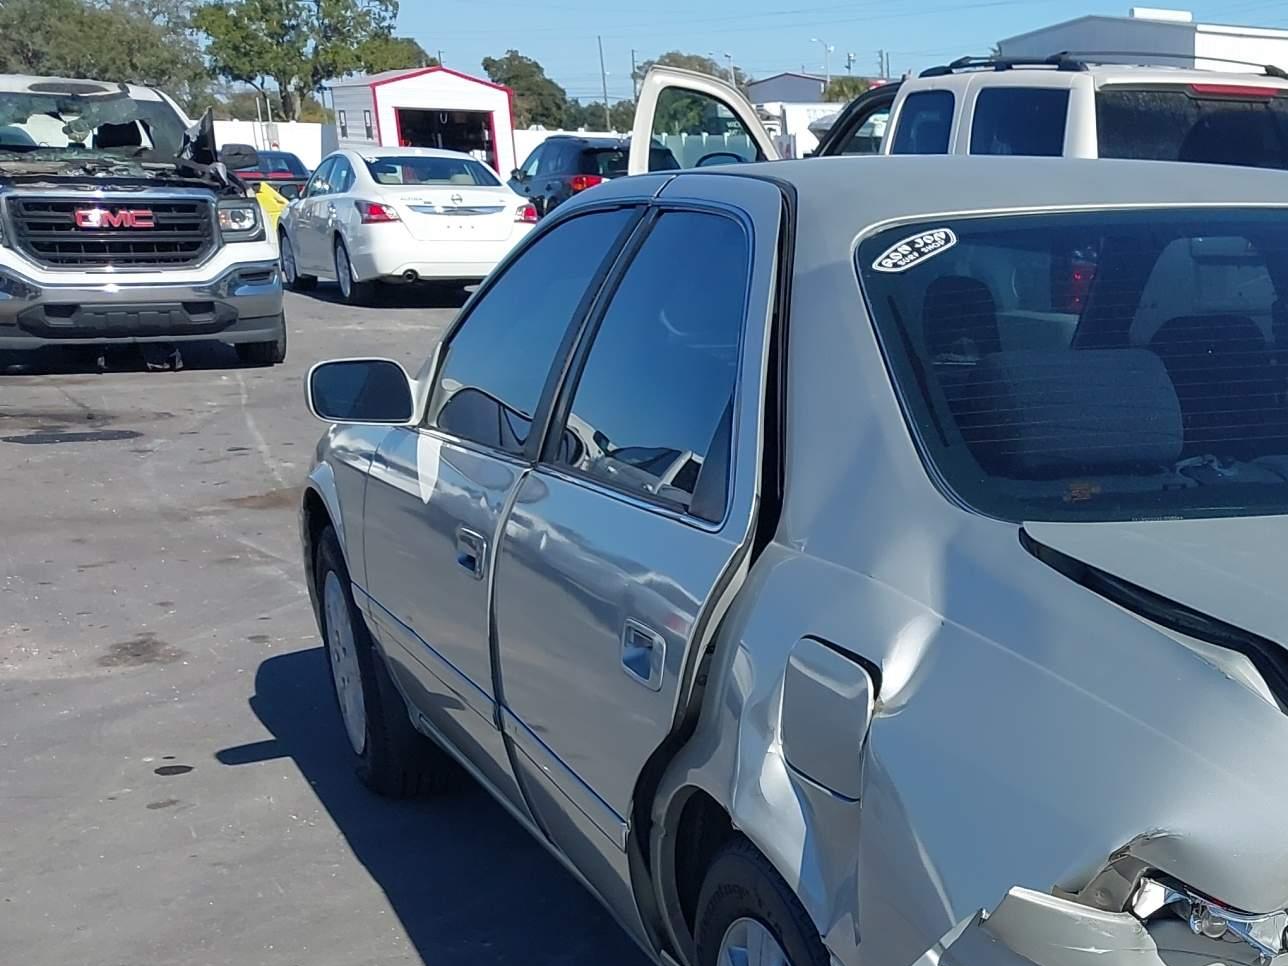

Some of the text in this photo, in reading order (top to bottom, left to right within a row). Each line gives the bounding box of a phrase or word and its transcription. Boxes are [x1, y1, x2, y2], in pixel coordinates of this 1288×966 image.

[75, 209, 154, 227] GMC
[881, 231, 947, 268] RON JON
[896, 239, 946, 266] SURF SHOP
